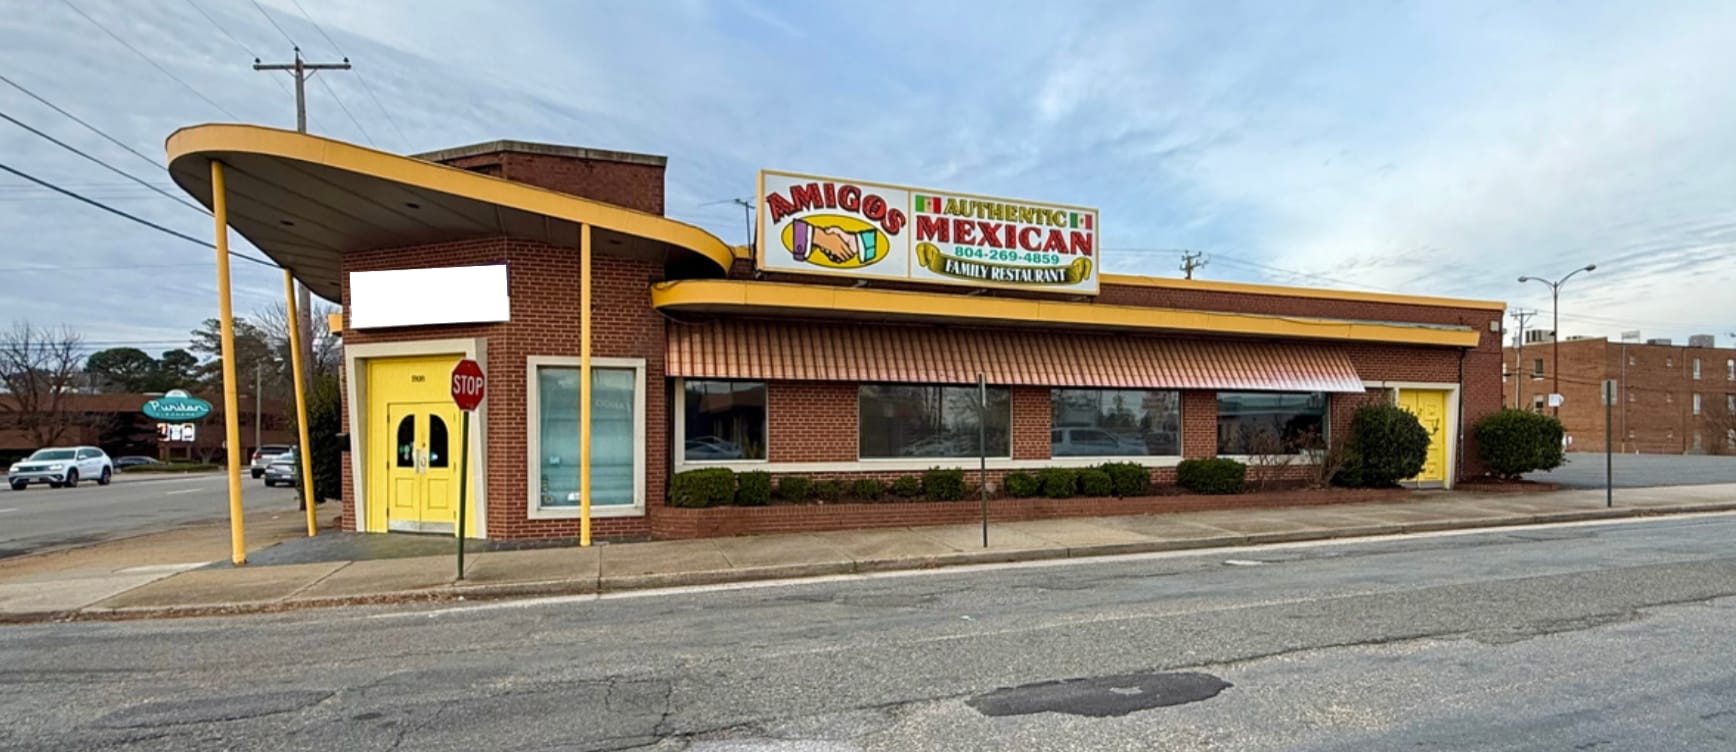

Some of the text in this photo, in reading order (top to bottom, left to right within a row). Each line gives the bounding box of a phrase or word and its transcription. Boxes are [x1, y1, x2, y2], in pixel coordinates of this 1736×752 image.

[766, 183, 906, 235] AMIGOS
[944, 198, 1067, 228] AUTHENTIC
[916, 215, 1093, 256] MEXICAN
[955, 246, 1060, 265] 804-269-4859
[945, 260, 1067, 282] FAMILY RESTAURANT
[453, 375, 484, 395] STOP
[148, 400, 209, 411] Puritan
